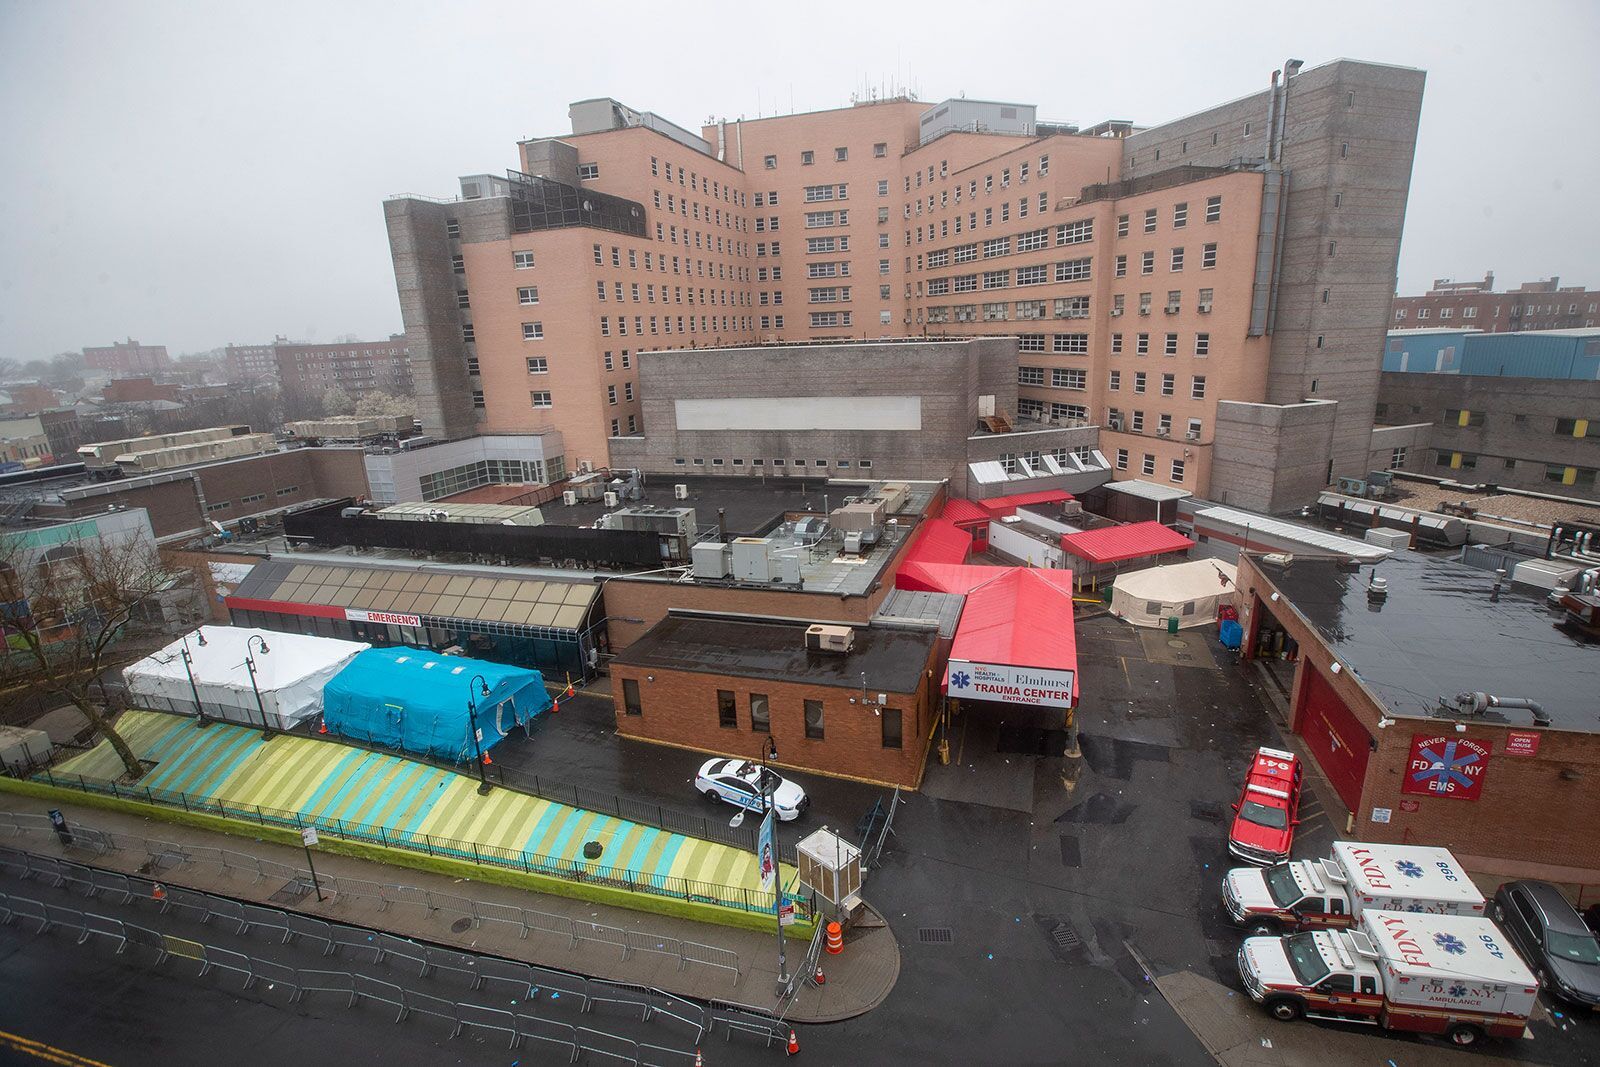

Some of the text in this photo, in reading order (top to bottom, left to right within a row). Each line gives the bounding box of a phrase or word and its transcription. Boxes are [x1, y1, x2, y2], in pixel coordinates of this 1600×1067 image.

[368, 612, 419, 625] EMERGENCY
[1016, 674, 1070, 688] Elmhurst
[974, 683, 1069, 700] TRAUMA CENTER
[1002, 695, 1041, 704] ENTRANCE
[1418, 736, 1446, 749] NEVER
[1458, 738, 1488, 757] FORGET
[1412, 760, 1483, 776] FD NY
[1428, 780, 1455, 792] EMS
[1349, 846, 1392, 890] FDNY
[1435, 861, 1458, 882] 398
[1382, 914, 1431, 968] FDNY
[1478, 934, 1505, 959] 436
[1420, 984, 1496, 999] F.D. N.Y.
[1429, 996, 1482, 1006] AMBULANCE
